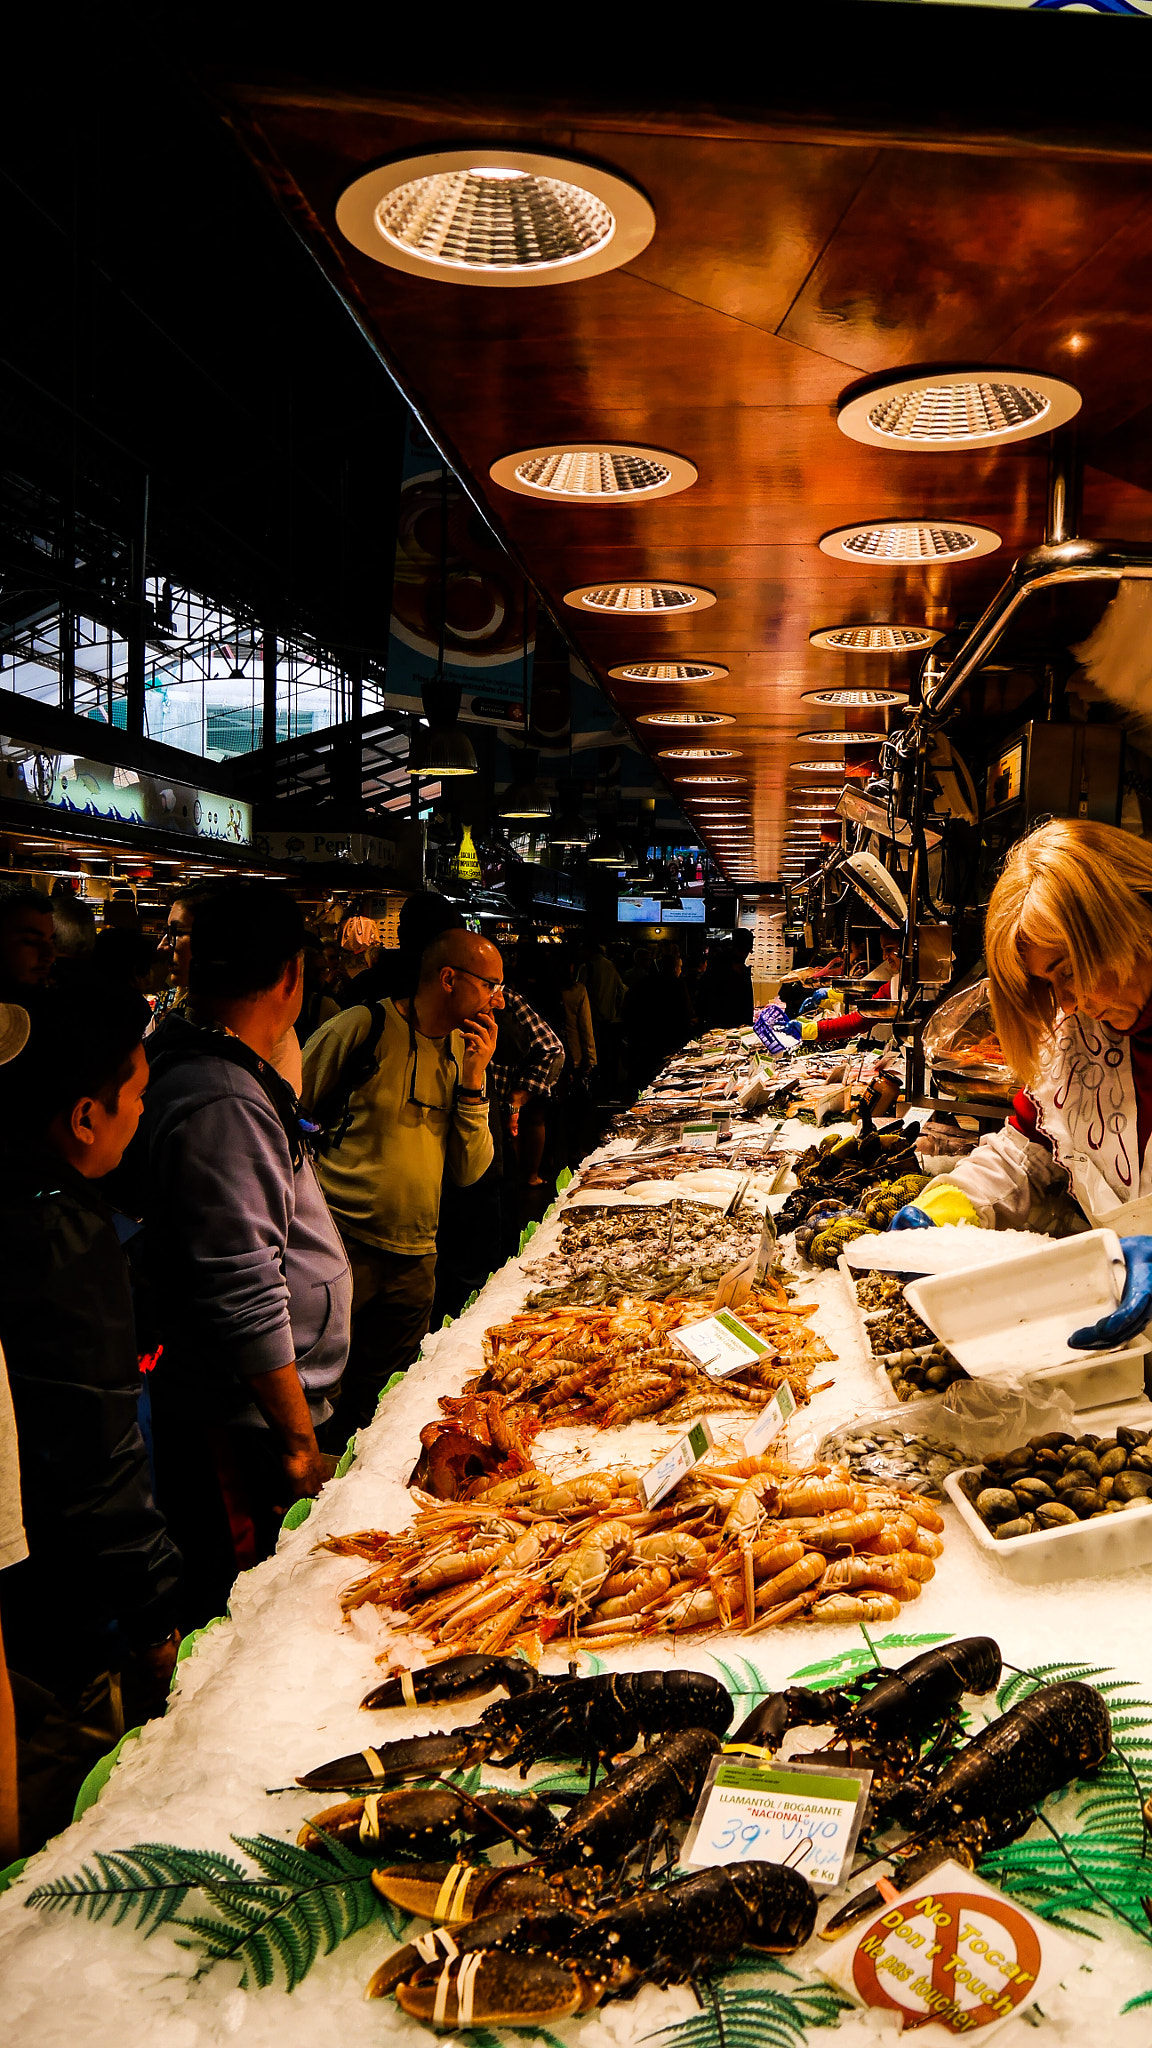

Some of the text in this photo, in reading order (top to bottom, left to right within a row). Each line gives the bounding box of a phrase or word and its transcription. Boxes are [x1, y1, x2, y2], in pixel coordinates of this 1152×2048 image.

[743, 905, 756, 914] 50
[719, 1794, 775, 1809] LLAMANTÓL
[783, 1801, 843, 1817] BOGABANTE
[810, 1868, 835, 1881] € Kg
[880, 1909, 1016, 2017] Don't Touch
[914, 1895, 1035, 1986] No Tocar
[859, 1934, 978, 2033] Ne pas toucher
